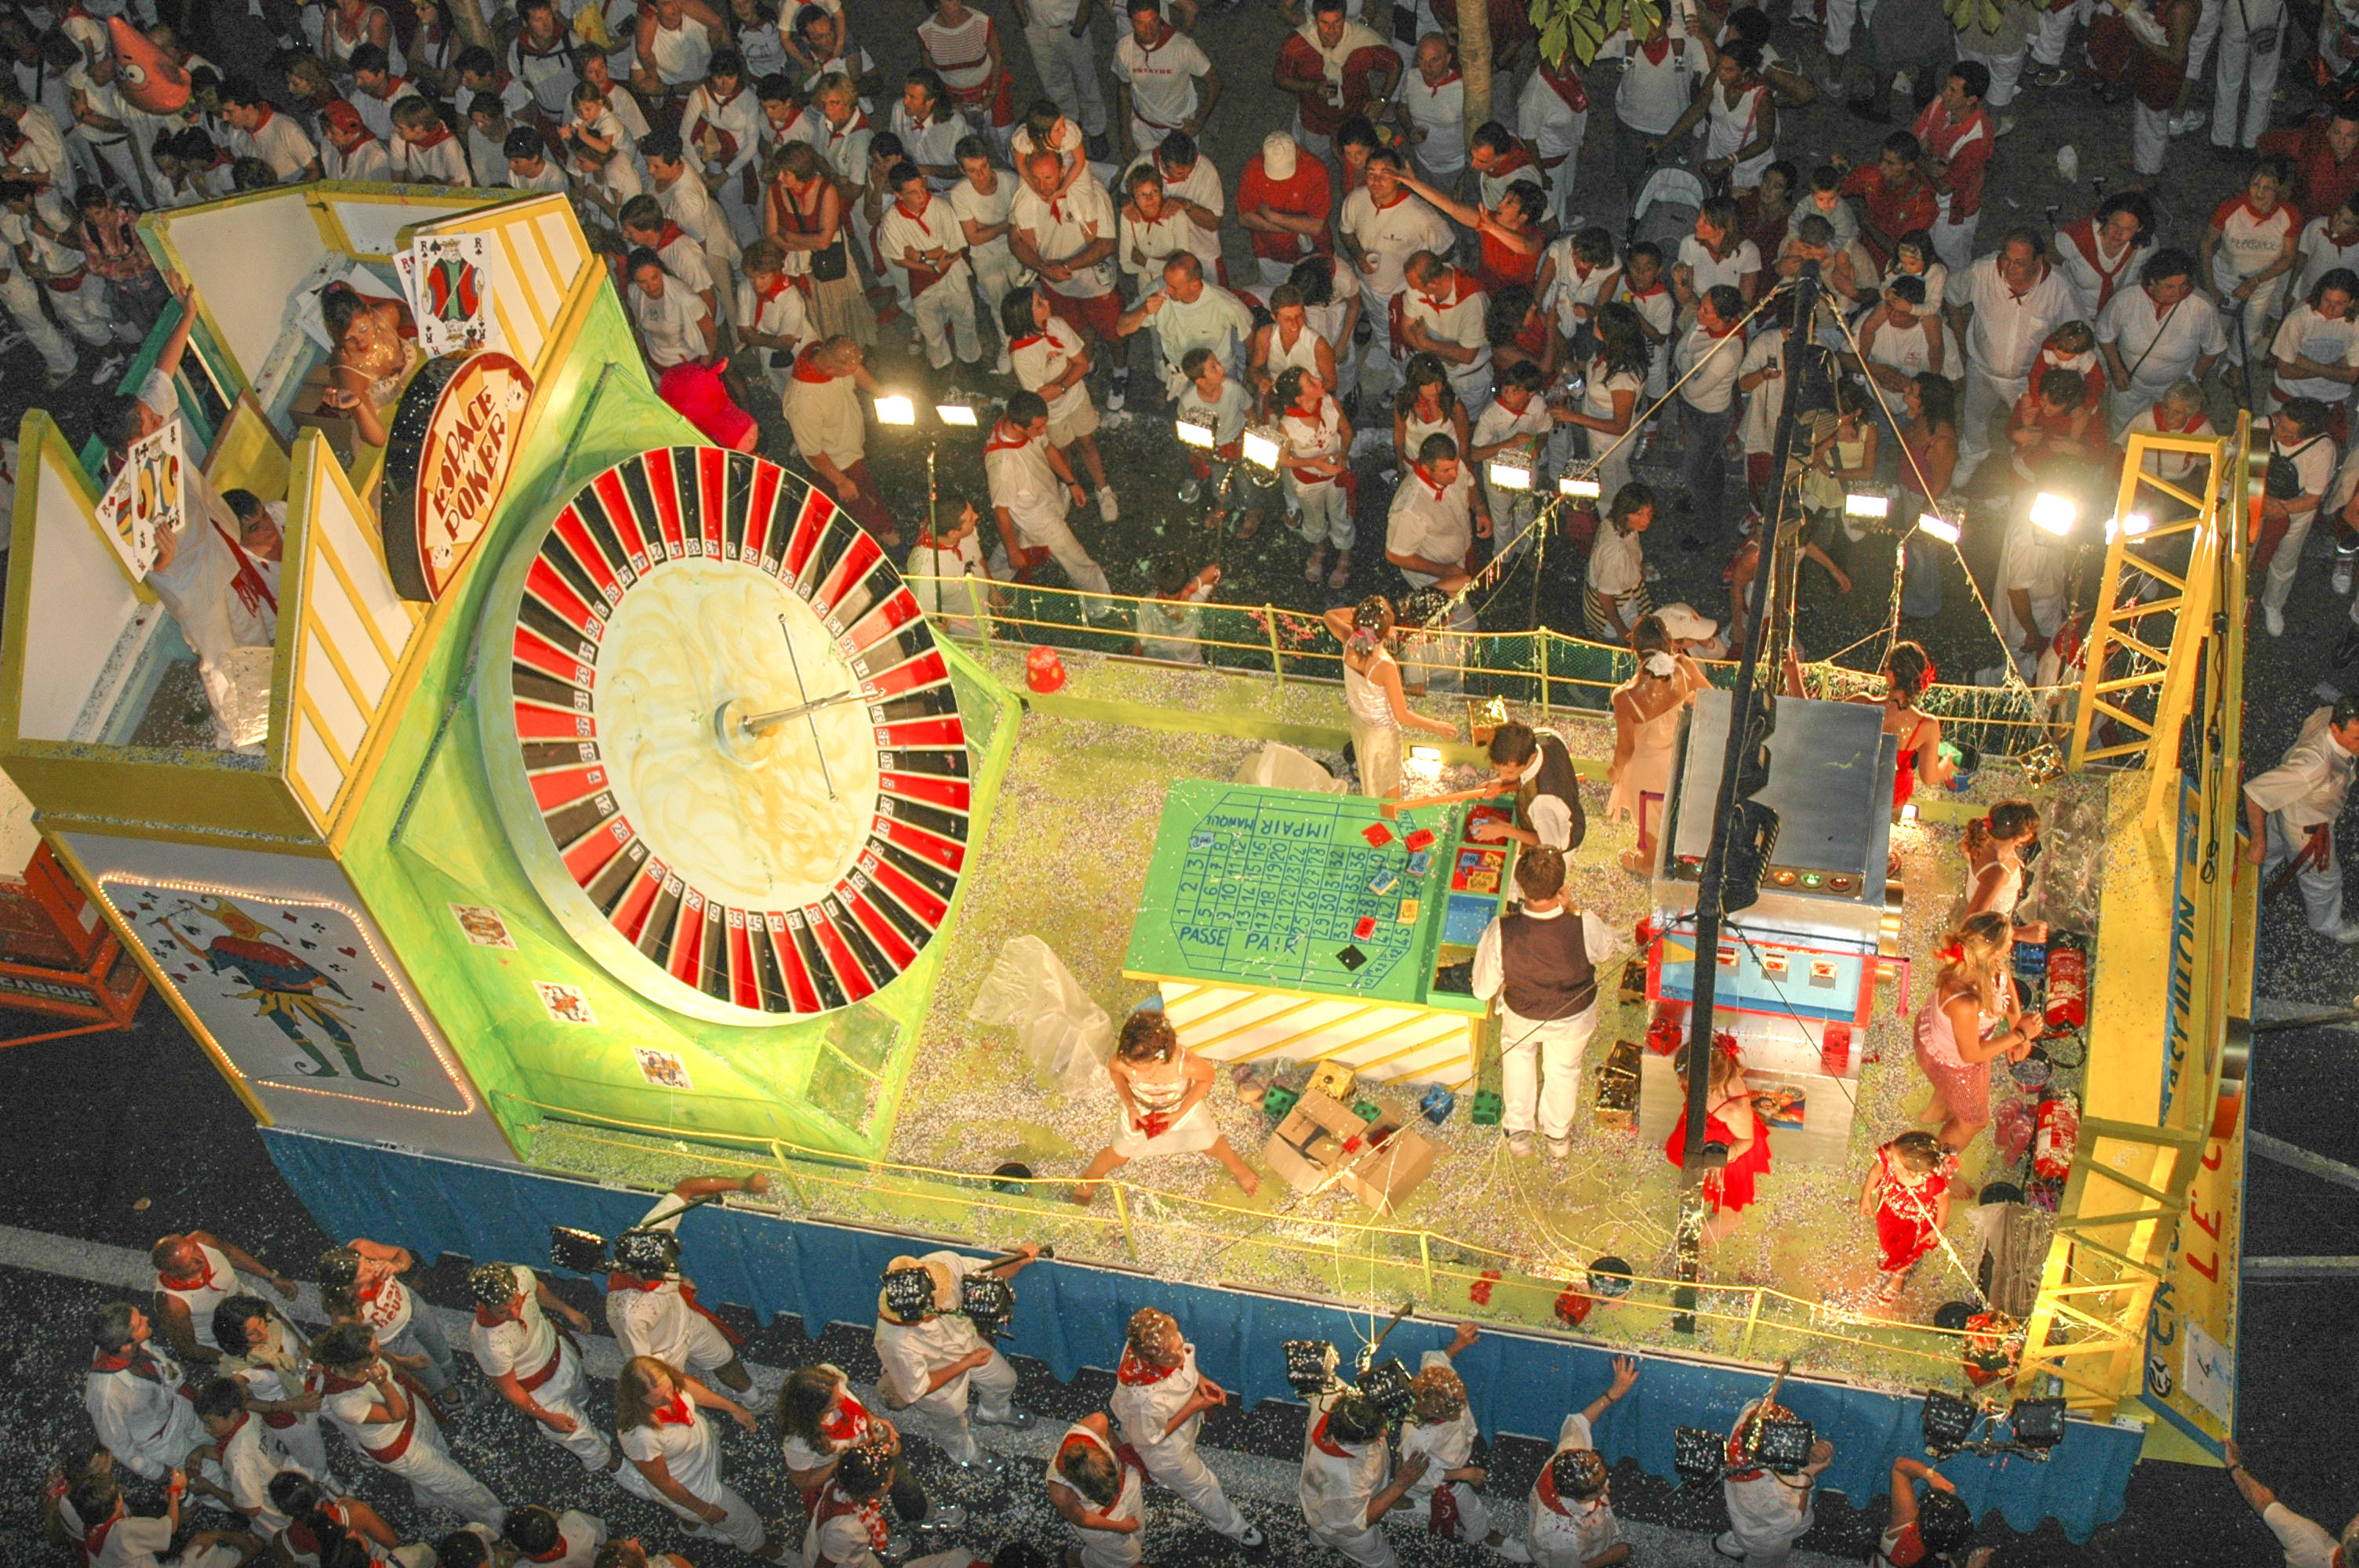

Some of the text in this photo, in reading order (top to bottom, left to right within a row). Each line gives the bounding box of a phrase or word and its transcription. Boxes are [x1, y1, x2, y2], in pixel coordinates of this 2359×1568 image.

[433, 385, 496, 520] ESPACE
[444, 412, 506, 543] POKER
[652, 544, 663, 560] 21
[669, 542, 681, 557] 47
[686, 539, 700, 554] 38
[728, 543, 735, 557] 2
[633, 554, 645, 571] 44
[745, 549, 758, 562] 25
[764, 558, 777, 574] 17
[617, 568, 631, 585] 42
[781, 570, 794, 586] 34
[605, 584, 620, 601] 39
[594, 602, 607, 615] 3
[814, 601, 828, 616] 27
[586, 619, 600, 638] 26
[829, 618, 841, 635] 13
[842, 637, 856, 652] 36
[576, 666, 589, 686] 32
[855, 660, 867, 675] 11
[575, 691, 588, 709] 15
[871, 706, 885, 722] 37
[878, 729, 889, 746] 48
[581, 743, 594, 760] 19
[881, 753, 892, 770] 30
[589, 772, 601, 782] 4
[597, 797, 612, 814] 12
[881, 798, 893, 815] 23
[612, 822, 628, 840] 28
[878, 820, 889, 836] 10
[1260, 819, 1329, 839] IMPAIR
[632, 846, 644, 858] 7
[872, 840, 882, 853] 5
[1214, 841, 1228, 851] 8
[1252, 841, 1267, 857] 16
[1269, 843, 1287, 862] 20
[1187, 858, 1204, 869] 3
[1289, 847, 1306, 863] 24
[1307, 847, 1325, 864] 28
[1329, 851, 1344, 867] 32
[1350, 852, 1366, 869] 36
[1368, 853, 1386, 871] 40
[647, 862, 663, 880] 29
[863, 855, 876, 874] 24
[1227, 863, 1241, 876] 11
[1245, 864, 1262, 877] 15
[1266, 863, 1282, 880] 19
[852, 873, 866, 889] 16
[1284, 867, 1301, 883] 23
[1303, 869, 1321, 886] 27
[1325, 871, 1341, 889] 31
[1345, 874, 1361, 892] 35
[667, 877, 681, 896] 18
[1180, 882, 1198, 891] 2
[1204, 887, 1218, 895] 6
[1221, 884, 1237, 901] 10
[1241, 887, 1256, 902] 14
[686, 891, 701, 909] 22
[1260, 890, 1276, 906] 18
[1279, 889, 1296, 906] 22
[1298, 891, 1317, 909] 26
[1319, 894, 1337, 912] 30
[1339, 898, 1356, 914] 34
[711, 906, 718, 920] 9
[807, 908, 821, 924] 20
[1198, 909, 1212, 917] 5
[1235, 910, 1251, 927] 13
[1379, 901, 1396, 919] 42
[729, 911, 742, 927] 35
[749, 916, 762, 931] 45
[770, 916, 783, 930] 14
[787, 913, 801, 928] 31
[1255, 912, 1270, 928] 17
[1274, 914, 1291, 931] 21
[1292, 916, 1310, 935] 25
[1312, 917, 1331, 937] 29
[1180, 926, 1228, 946] PASSE
[1332, 921, 1348, 939] 33
[1373, 927, 1391, 943] 41
[1394, 928, 1411, 946] 45
[1245, 932, 1296, 954] PAIR
